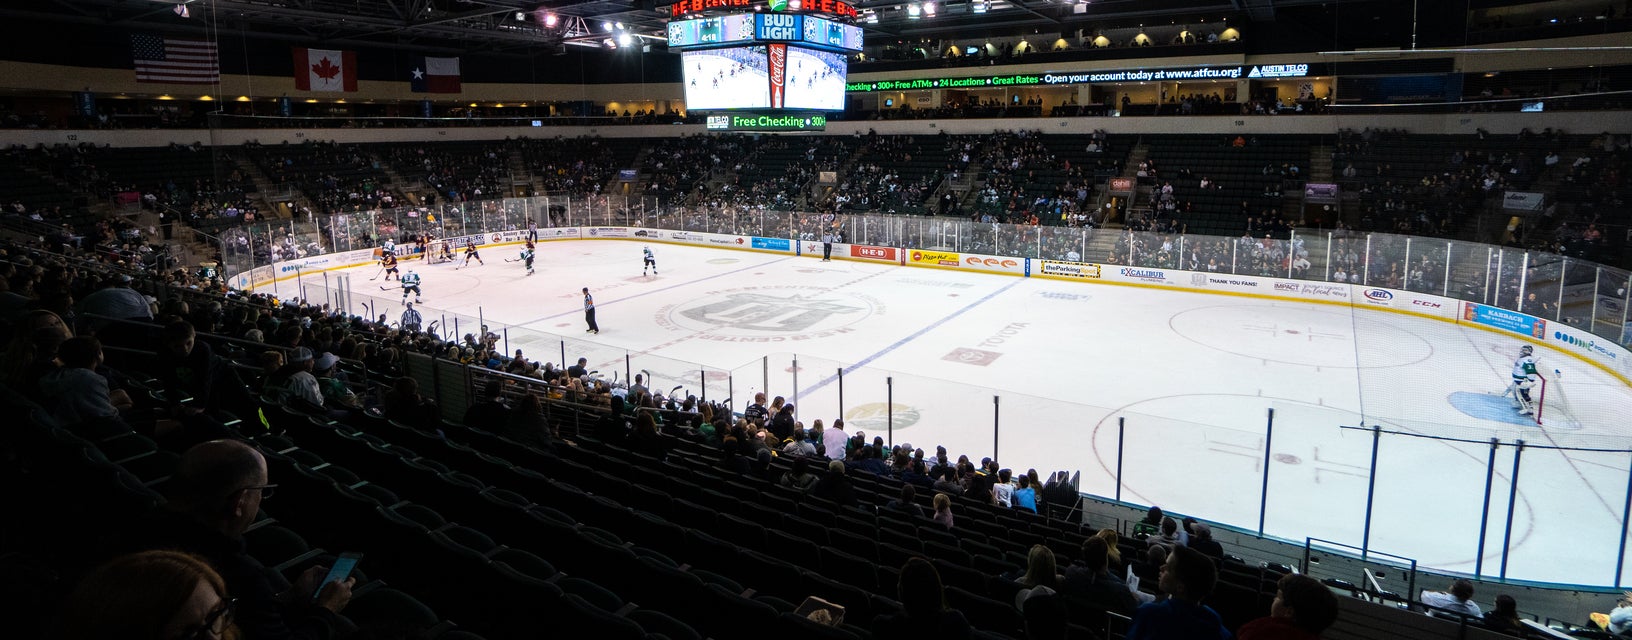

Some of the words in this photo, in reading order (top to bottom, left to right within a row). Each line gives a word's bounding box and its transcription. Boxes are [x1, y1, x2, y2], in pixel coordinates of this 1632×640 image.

[764, 14, 794, 27] BUD
[761, 27, 796, 40] LIGHT
[1261, 65, 1285, 73] AUSTIN
[1285, 64, 1308, 72] TELCO
[846, 83, 872, 92] hecking
[877, 82, 895, 90] 300+
[895, 81, 911, 90] Free
[911, 80, 933, 89] ATMs
[939, 79, 949, 88] 24
[949, 77, 986, 87] Locations
[992, 76, 1015, 86] Great
[1015, 75, 1039, 85] Rates
[1044, 74, 1068, 84] Open
[1069, 75, 1089, 84] your
[1090, 71, 1125, 81] account
[1126, 70, 1153, 82] today
[1154, 70, 1165, 79] at
[1165, 66, 1242, 79] www.atfcu.org!
[733, 117, 756, 127] Free
[758, 116, 804, 128] Checking
[1120, 267, 1164, 278] EXCALIBUR
[1274, 283, 1299, 291] IMPACT
[1312, 286, 1331, 296] local
[1369, 290, 1388, 299] AHL
[1412, 299, 1441, 309] CCM
[976, 321, 1032, 347] TOYOTA
